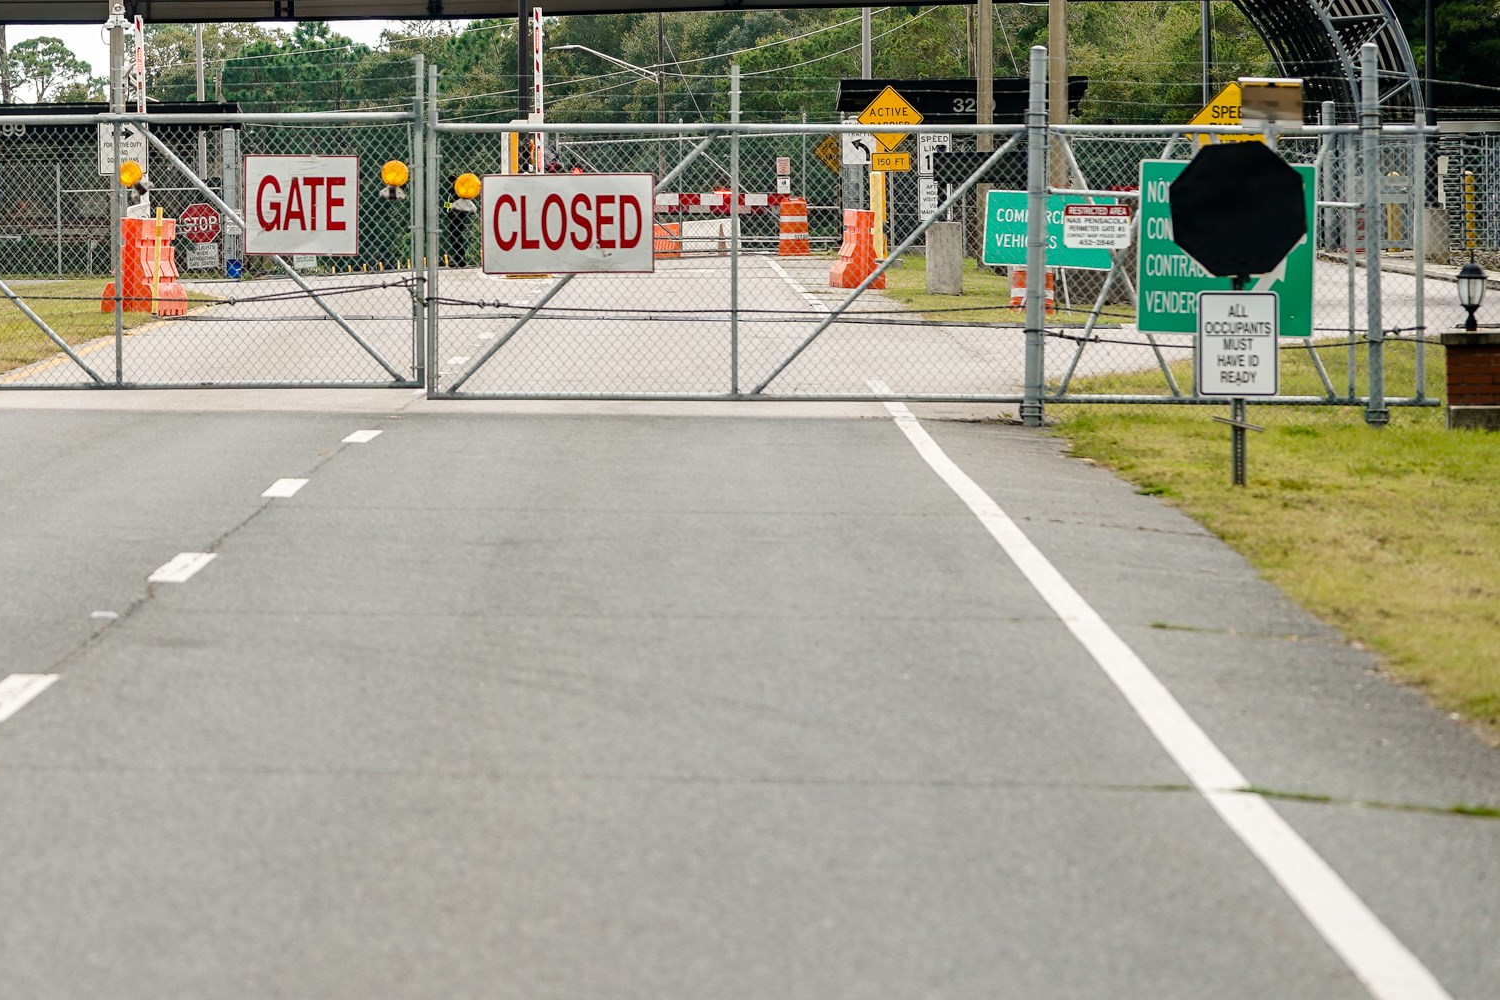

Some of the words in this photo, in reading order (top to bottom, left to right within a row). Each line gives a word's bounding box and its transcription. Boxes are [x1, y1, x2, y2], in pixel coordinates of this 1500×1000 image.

[869, 107, 909, 117] ACTIVE
[920, 135, 949, 143] SPEED
[877, 157, 891, 166] 150
[895, 157, 905, 166] FT
[256, 175, 346, 232] GATE
[1068, 206, 1108, 215] RESTRICTED
[1109, 206, 1127, 215] AREA
[183, 215, 217, 232] STOP
[493, 193, 642, 251] CLOSED
[1145, 290, 1199, 314] VENDER
[1228, 304, 1248, 317] ALL
[1205, 321, 1272, 334] OCCUPANTS
[1223, 338, 1253, 351] MUST
[1217, 354, 1245, 367] HAVE
[1248, 354, 1260, 367] ID
[1220, 371, 1257, 383] READY
